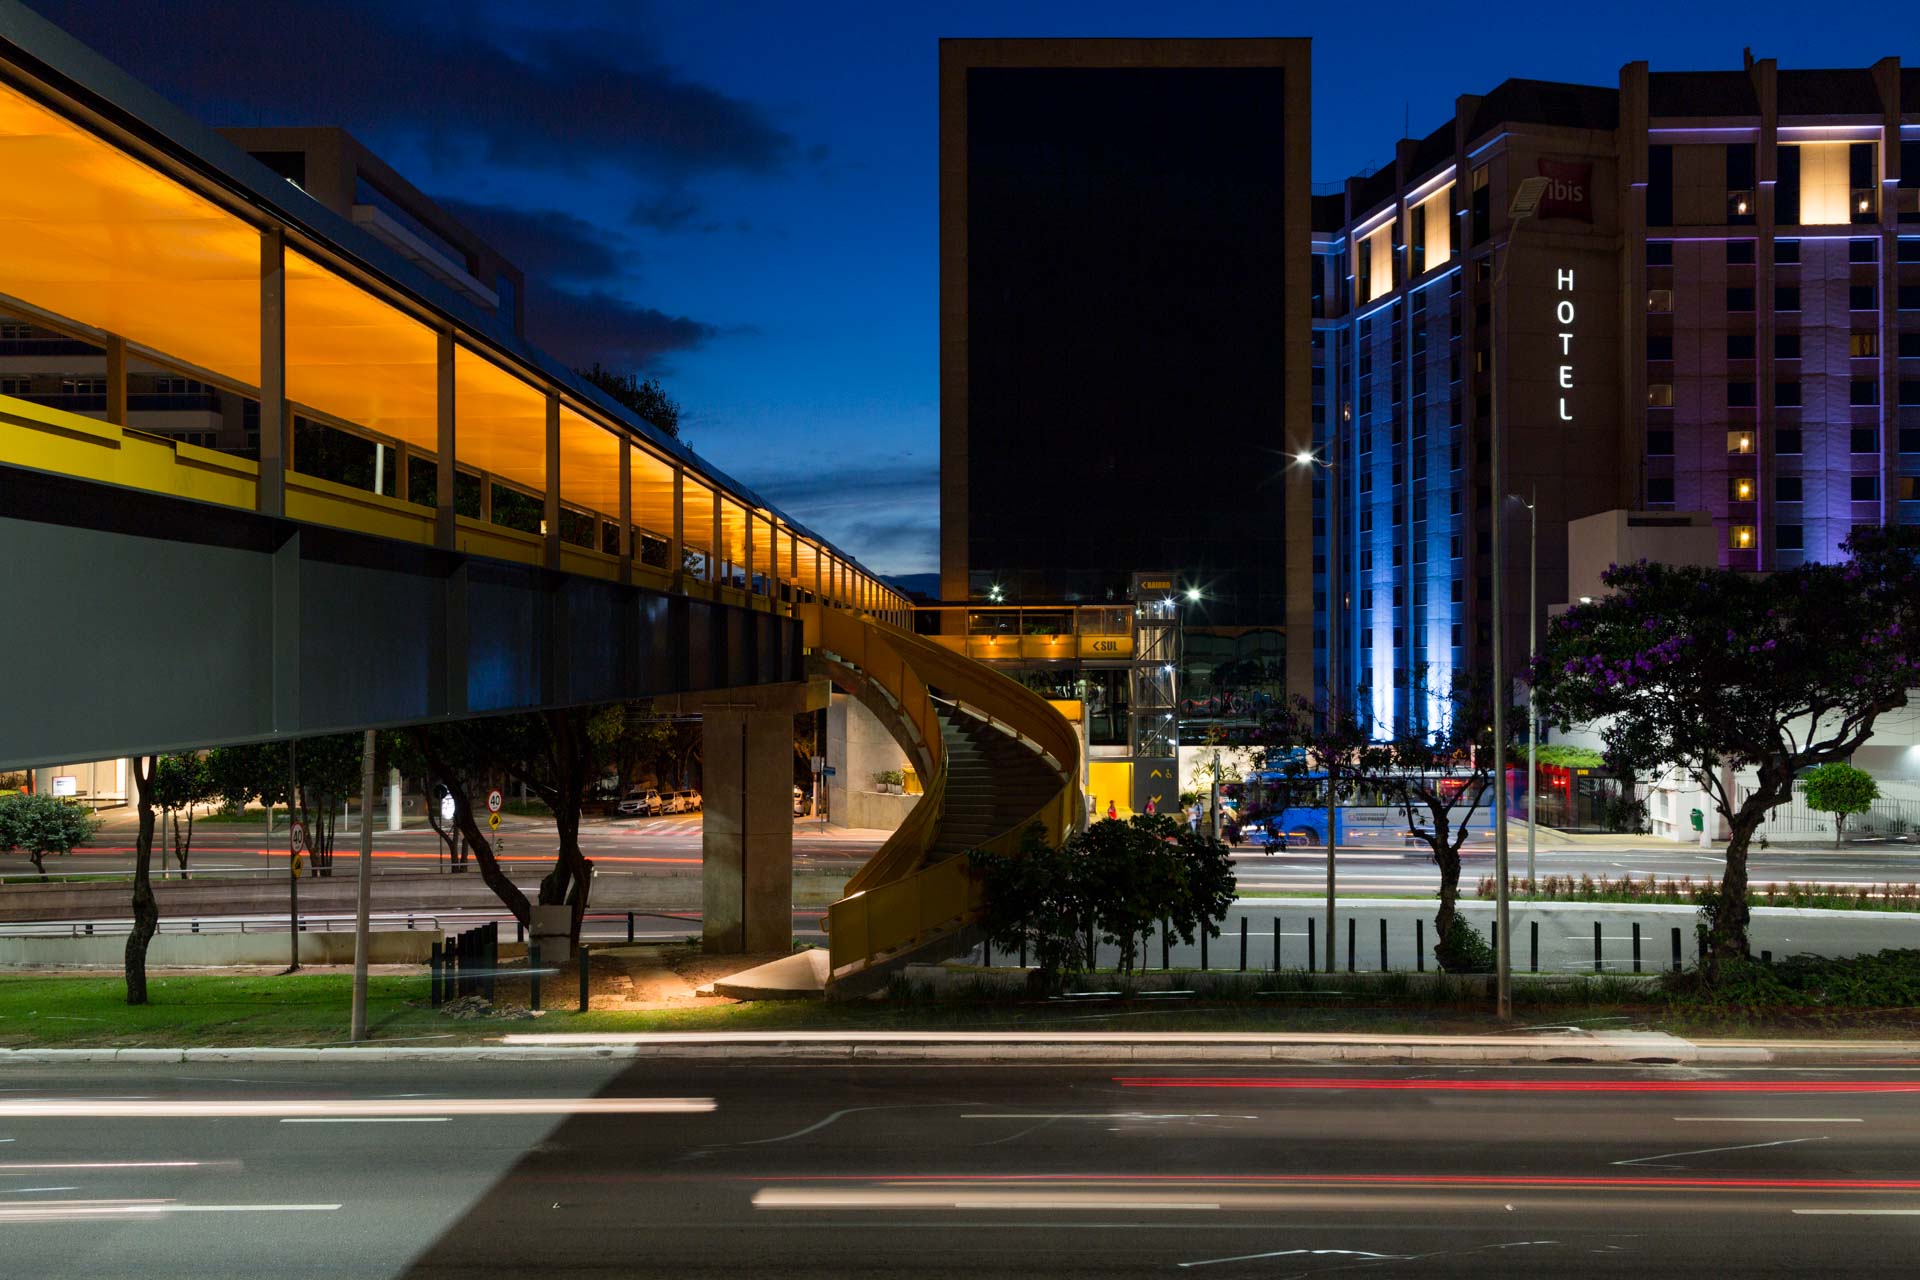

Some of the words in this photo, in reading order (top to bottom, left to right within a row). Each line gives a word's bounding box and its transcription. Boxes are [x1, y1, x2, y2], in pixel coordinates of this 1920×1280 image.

[1548, 178, 1584, 202] ibis
[1557, 268, 1575, 420] HOTEL
[1100, 640, 1118, 651] SUL
[490, 795, 500, 806] 40
[293, 830, 303, 844] 40
